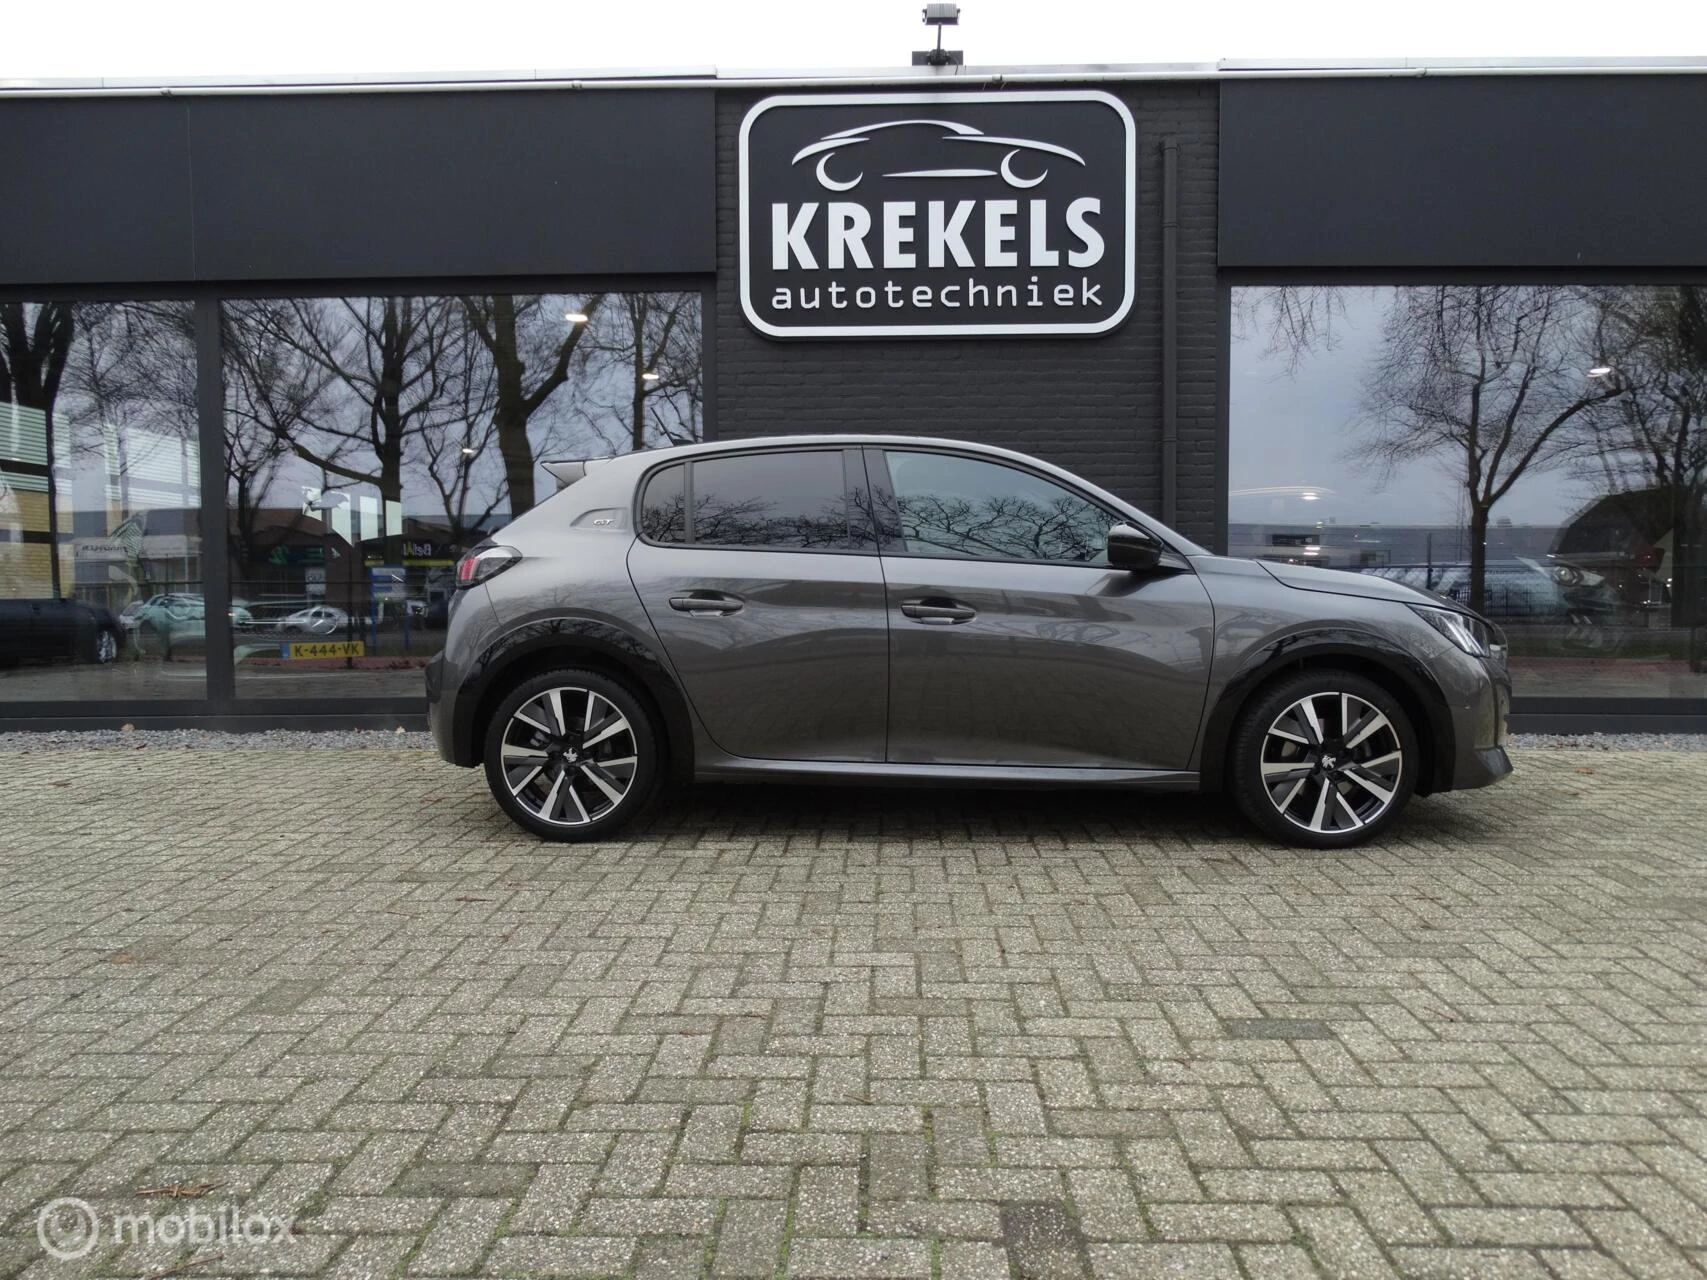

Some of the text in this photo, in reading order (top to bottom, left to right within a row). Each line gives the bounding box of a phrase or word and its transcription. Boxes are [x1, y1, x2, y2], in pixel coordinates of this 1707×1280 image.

[772, 197, 1104, 270] KREKELS
[772, 276, 1102, 310] autotechniek
[294, 642, 360, 657] K-444-VK
